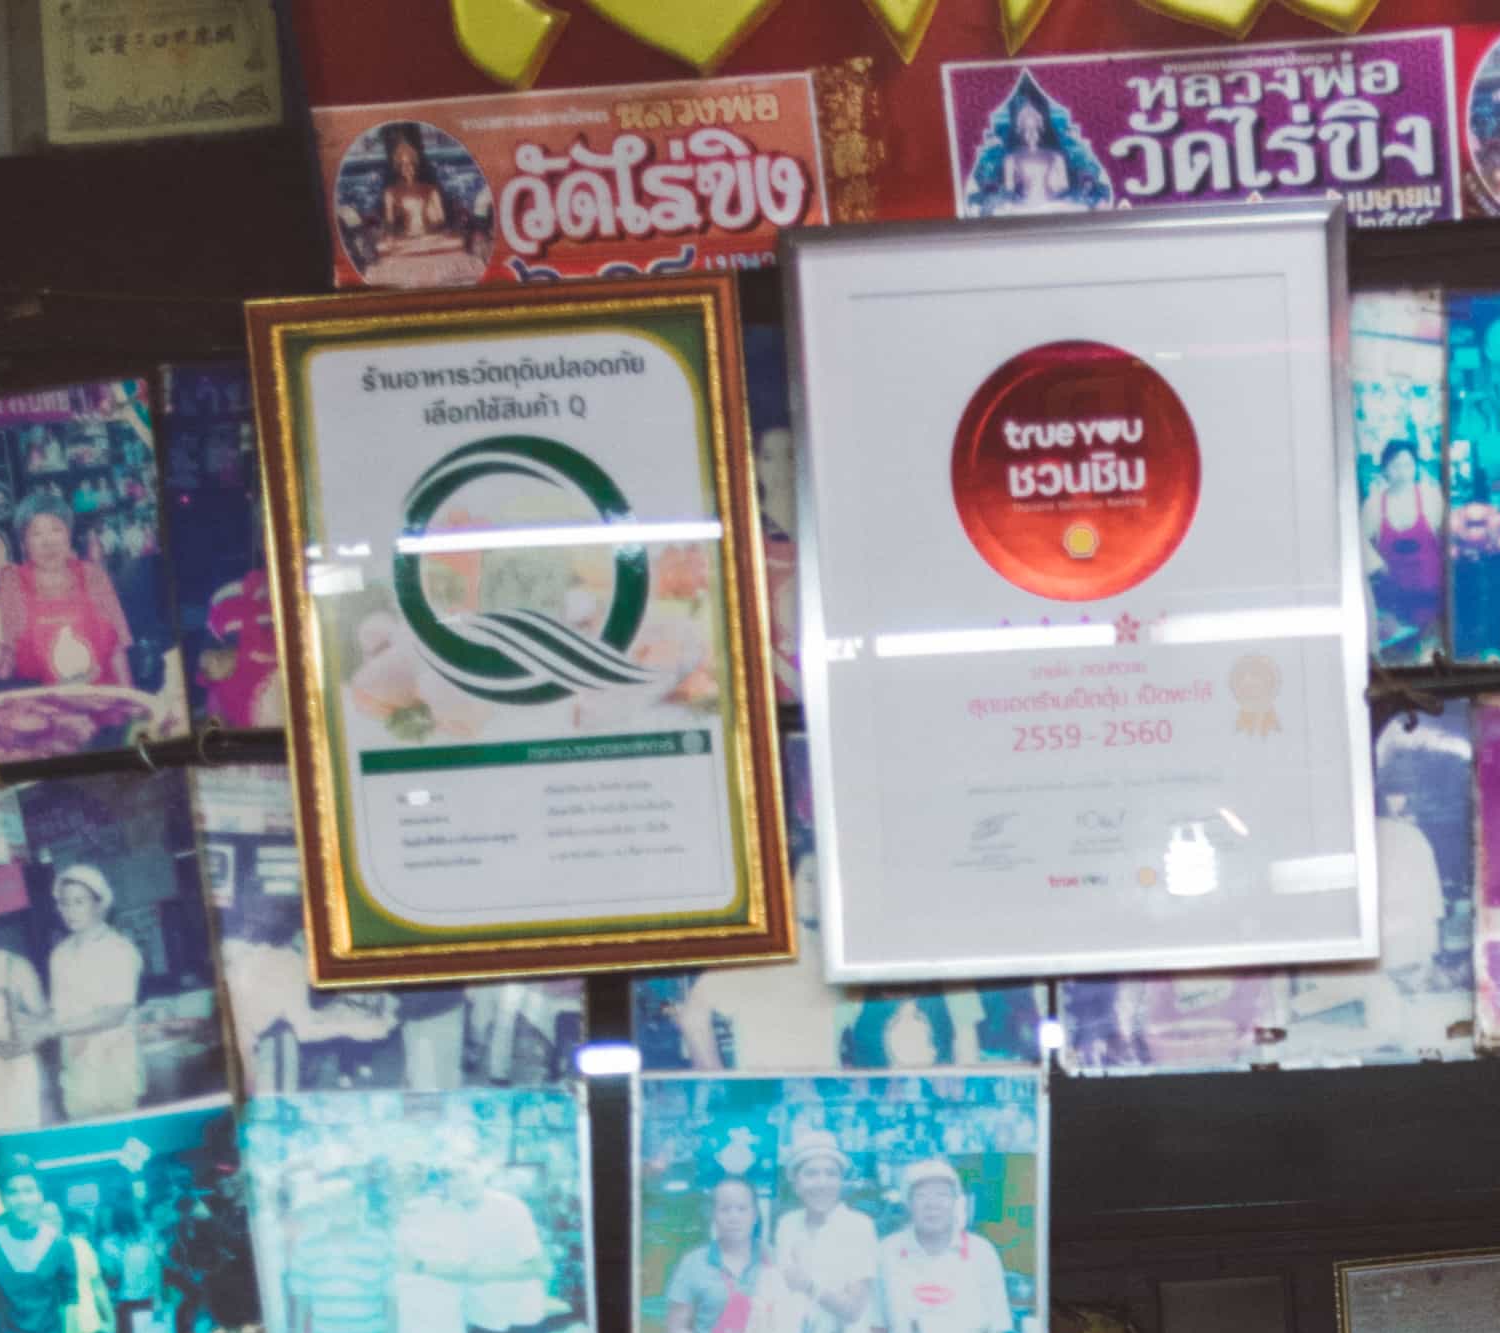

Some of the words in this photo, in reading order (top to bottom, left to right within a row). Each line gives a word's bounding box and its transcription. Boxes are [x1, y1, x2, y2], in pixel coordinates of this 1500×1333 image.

[1126, 52, 1400, 110] หลวงพ่อ
[1110, 99, 1436, 195] วัดไร่ขิง
[501, 127, 806, 253] วัดไร่ขิง
[1008, 451, 1146, 498] ชวนชิม
[1012, 723, 1082, 752] 2559
[1102, 718, 1174, 748] 2560
